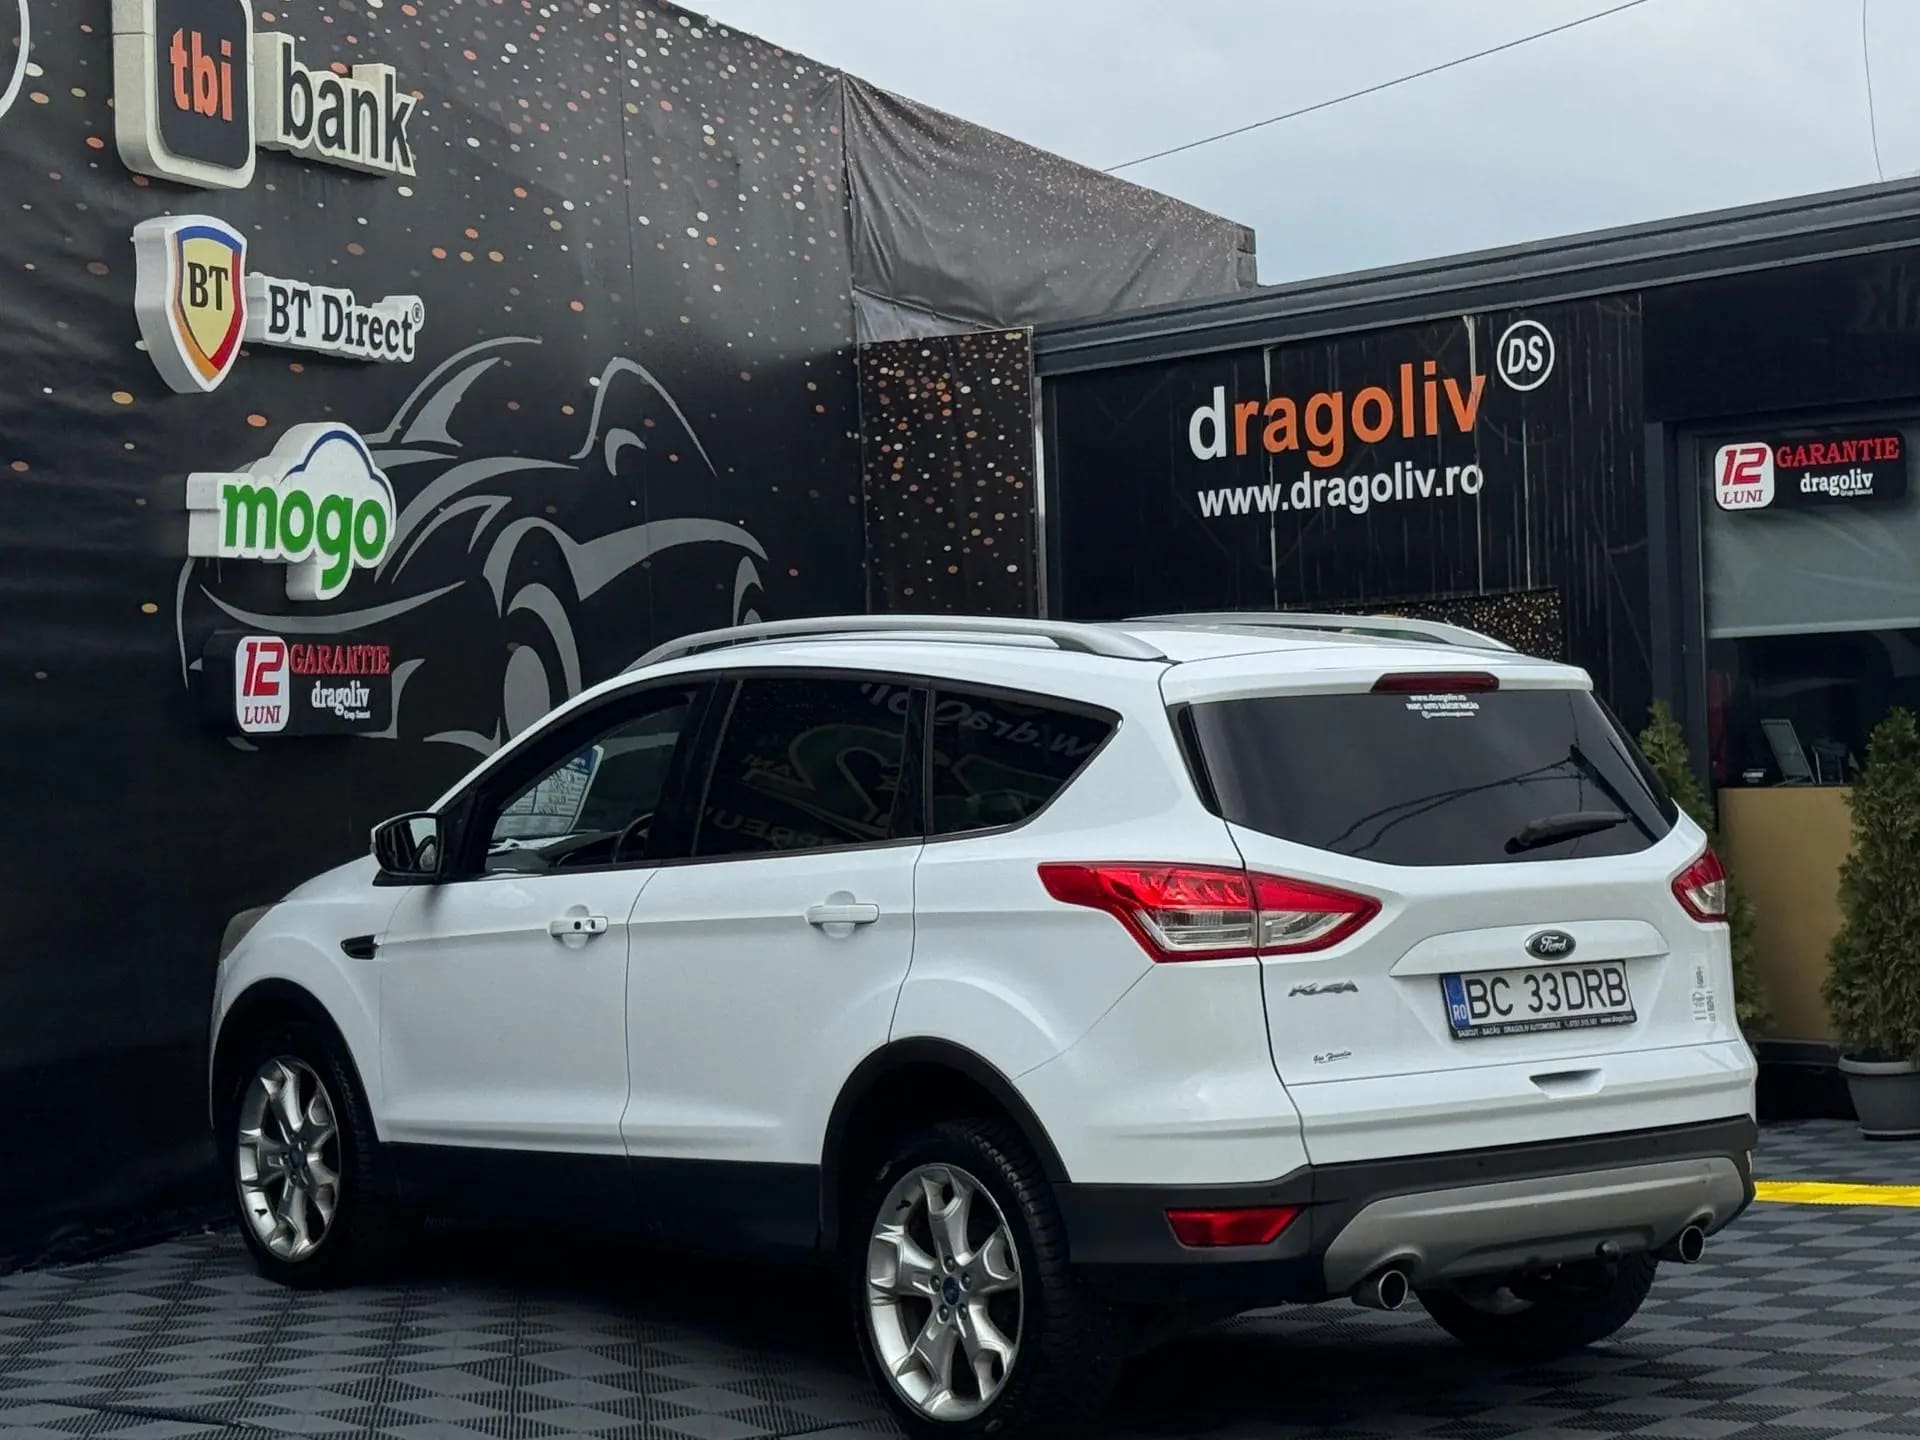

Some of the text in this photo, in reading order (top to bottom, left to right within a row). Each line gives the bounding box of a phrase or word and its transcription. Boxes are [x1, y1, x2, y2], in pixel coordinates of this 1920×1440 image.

[170, 28, 232, 121] tbi
[282, 42, 416, 170] bank
[187, 262, 228, 311] BT
[269, 285, 311, 338] BT
[1507, 336, 1543, 374] DS
[1189, 360, 1486, 467] dragoliv
[1722, 437, 1900, 485] 12 GARANTIE
[1800, 468, 1873, 496] dragoliv
[1198, 462, 1484, 517] www.dragoliv.ro
[1723, 490, 1763, 504] LUNI
[223, 484, 387, 590] mogo
[243, 642, 390, 696] 12 GARANTIE
[243, 705, 281, 724] LUNI
[311, 680, 370, 716] dragoliv
[1540, 935, 1567, 952] Ford
[1453, 1004, 1468, 1021] RO
[1466, 976, 1513, 1019] BC
